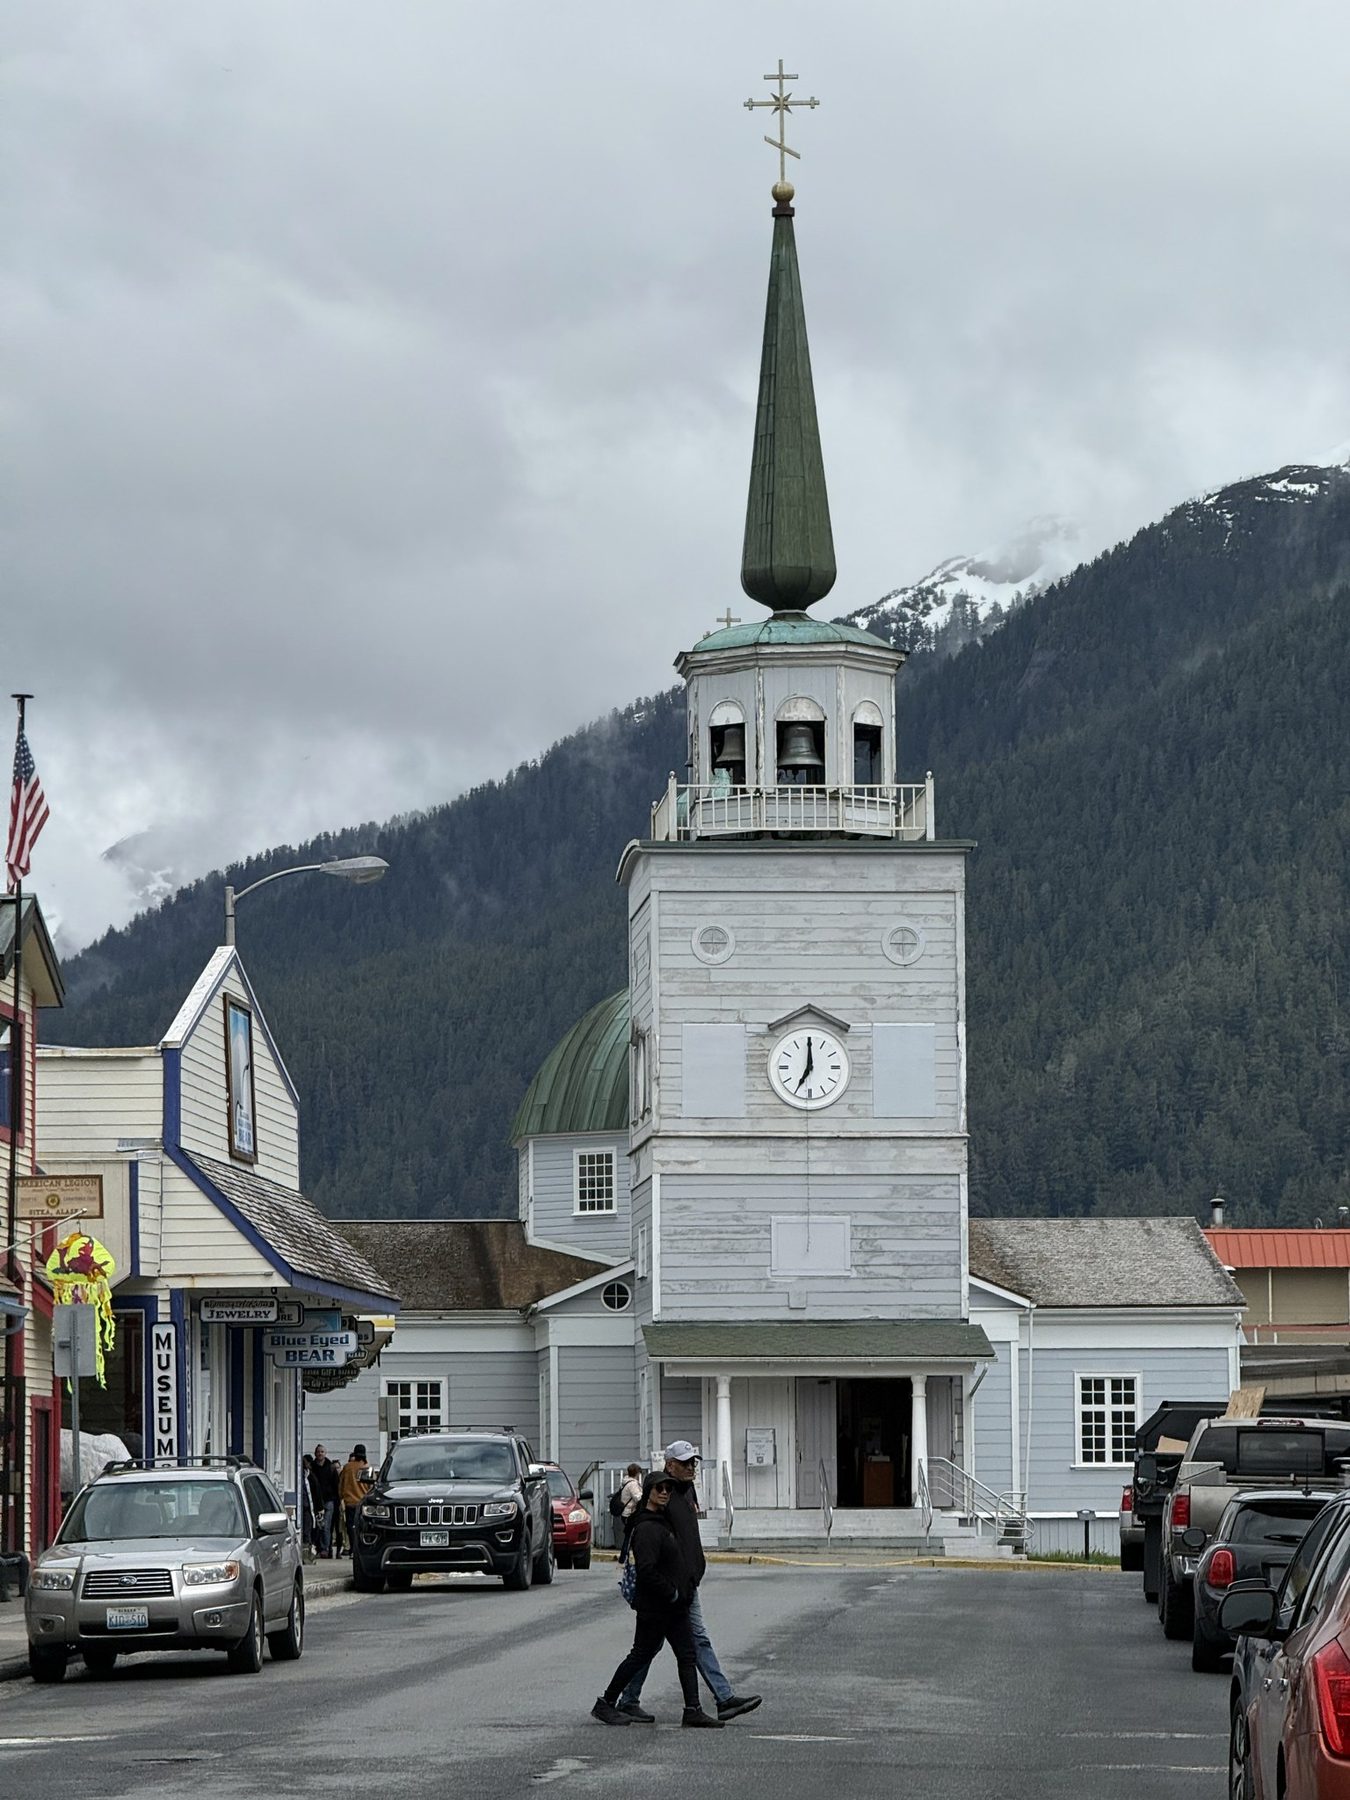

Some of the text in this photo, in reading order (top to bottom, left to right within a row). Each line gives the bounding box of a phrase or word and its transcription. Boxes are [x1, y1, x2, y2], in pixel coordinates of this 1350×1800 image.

[17, 1179, 97, 1188] AMERICAN LEGION
[206, 1309, 272, 1320] JEWELRY
[270, 1335, 307, 1346] Blue
[310, 1334, 350, 1347] Eyed
[285, 1349, 336, 1362] BEAR
[155, 1331, 174, 1457] MUSEUM
